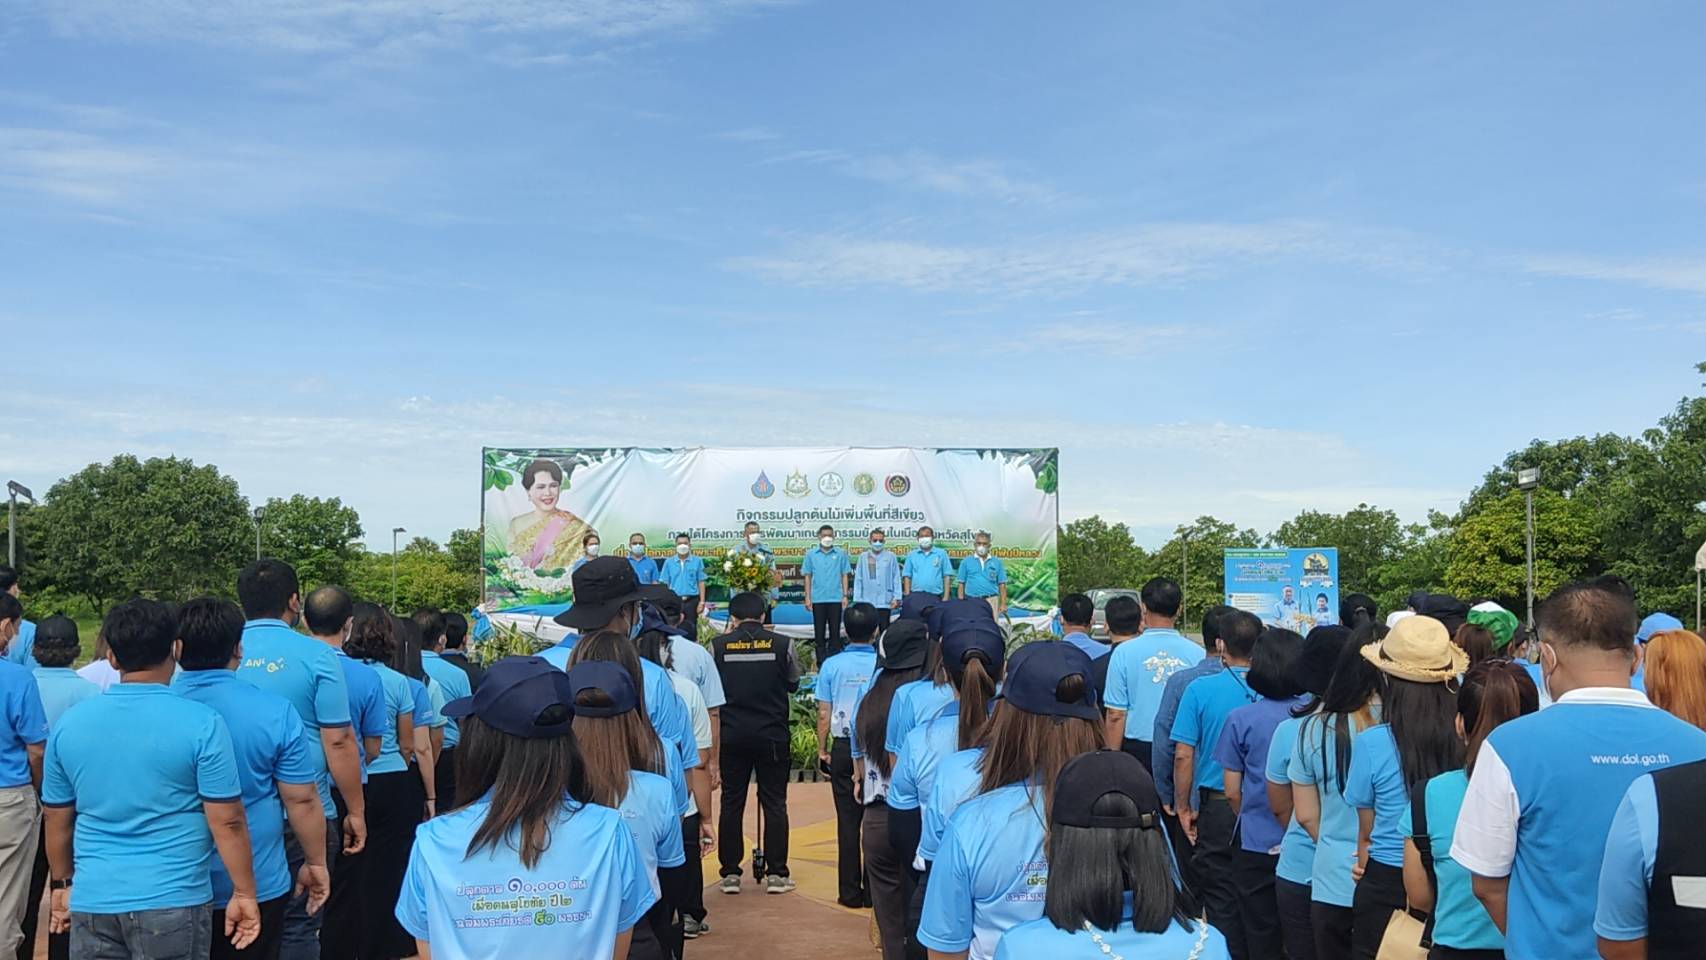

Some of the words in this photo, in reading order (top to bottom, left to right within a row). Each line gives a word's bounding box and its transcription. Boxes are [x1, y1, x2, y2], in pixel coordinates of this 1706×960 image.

[736, 504, 925, 524] กิจกรรมปลูกต้นไม้เพิ่มพื้นที่สีเขียว
[1590, 753, 1670, 767] www.dol.go.th
